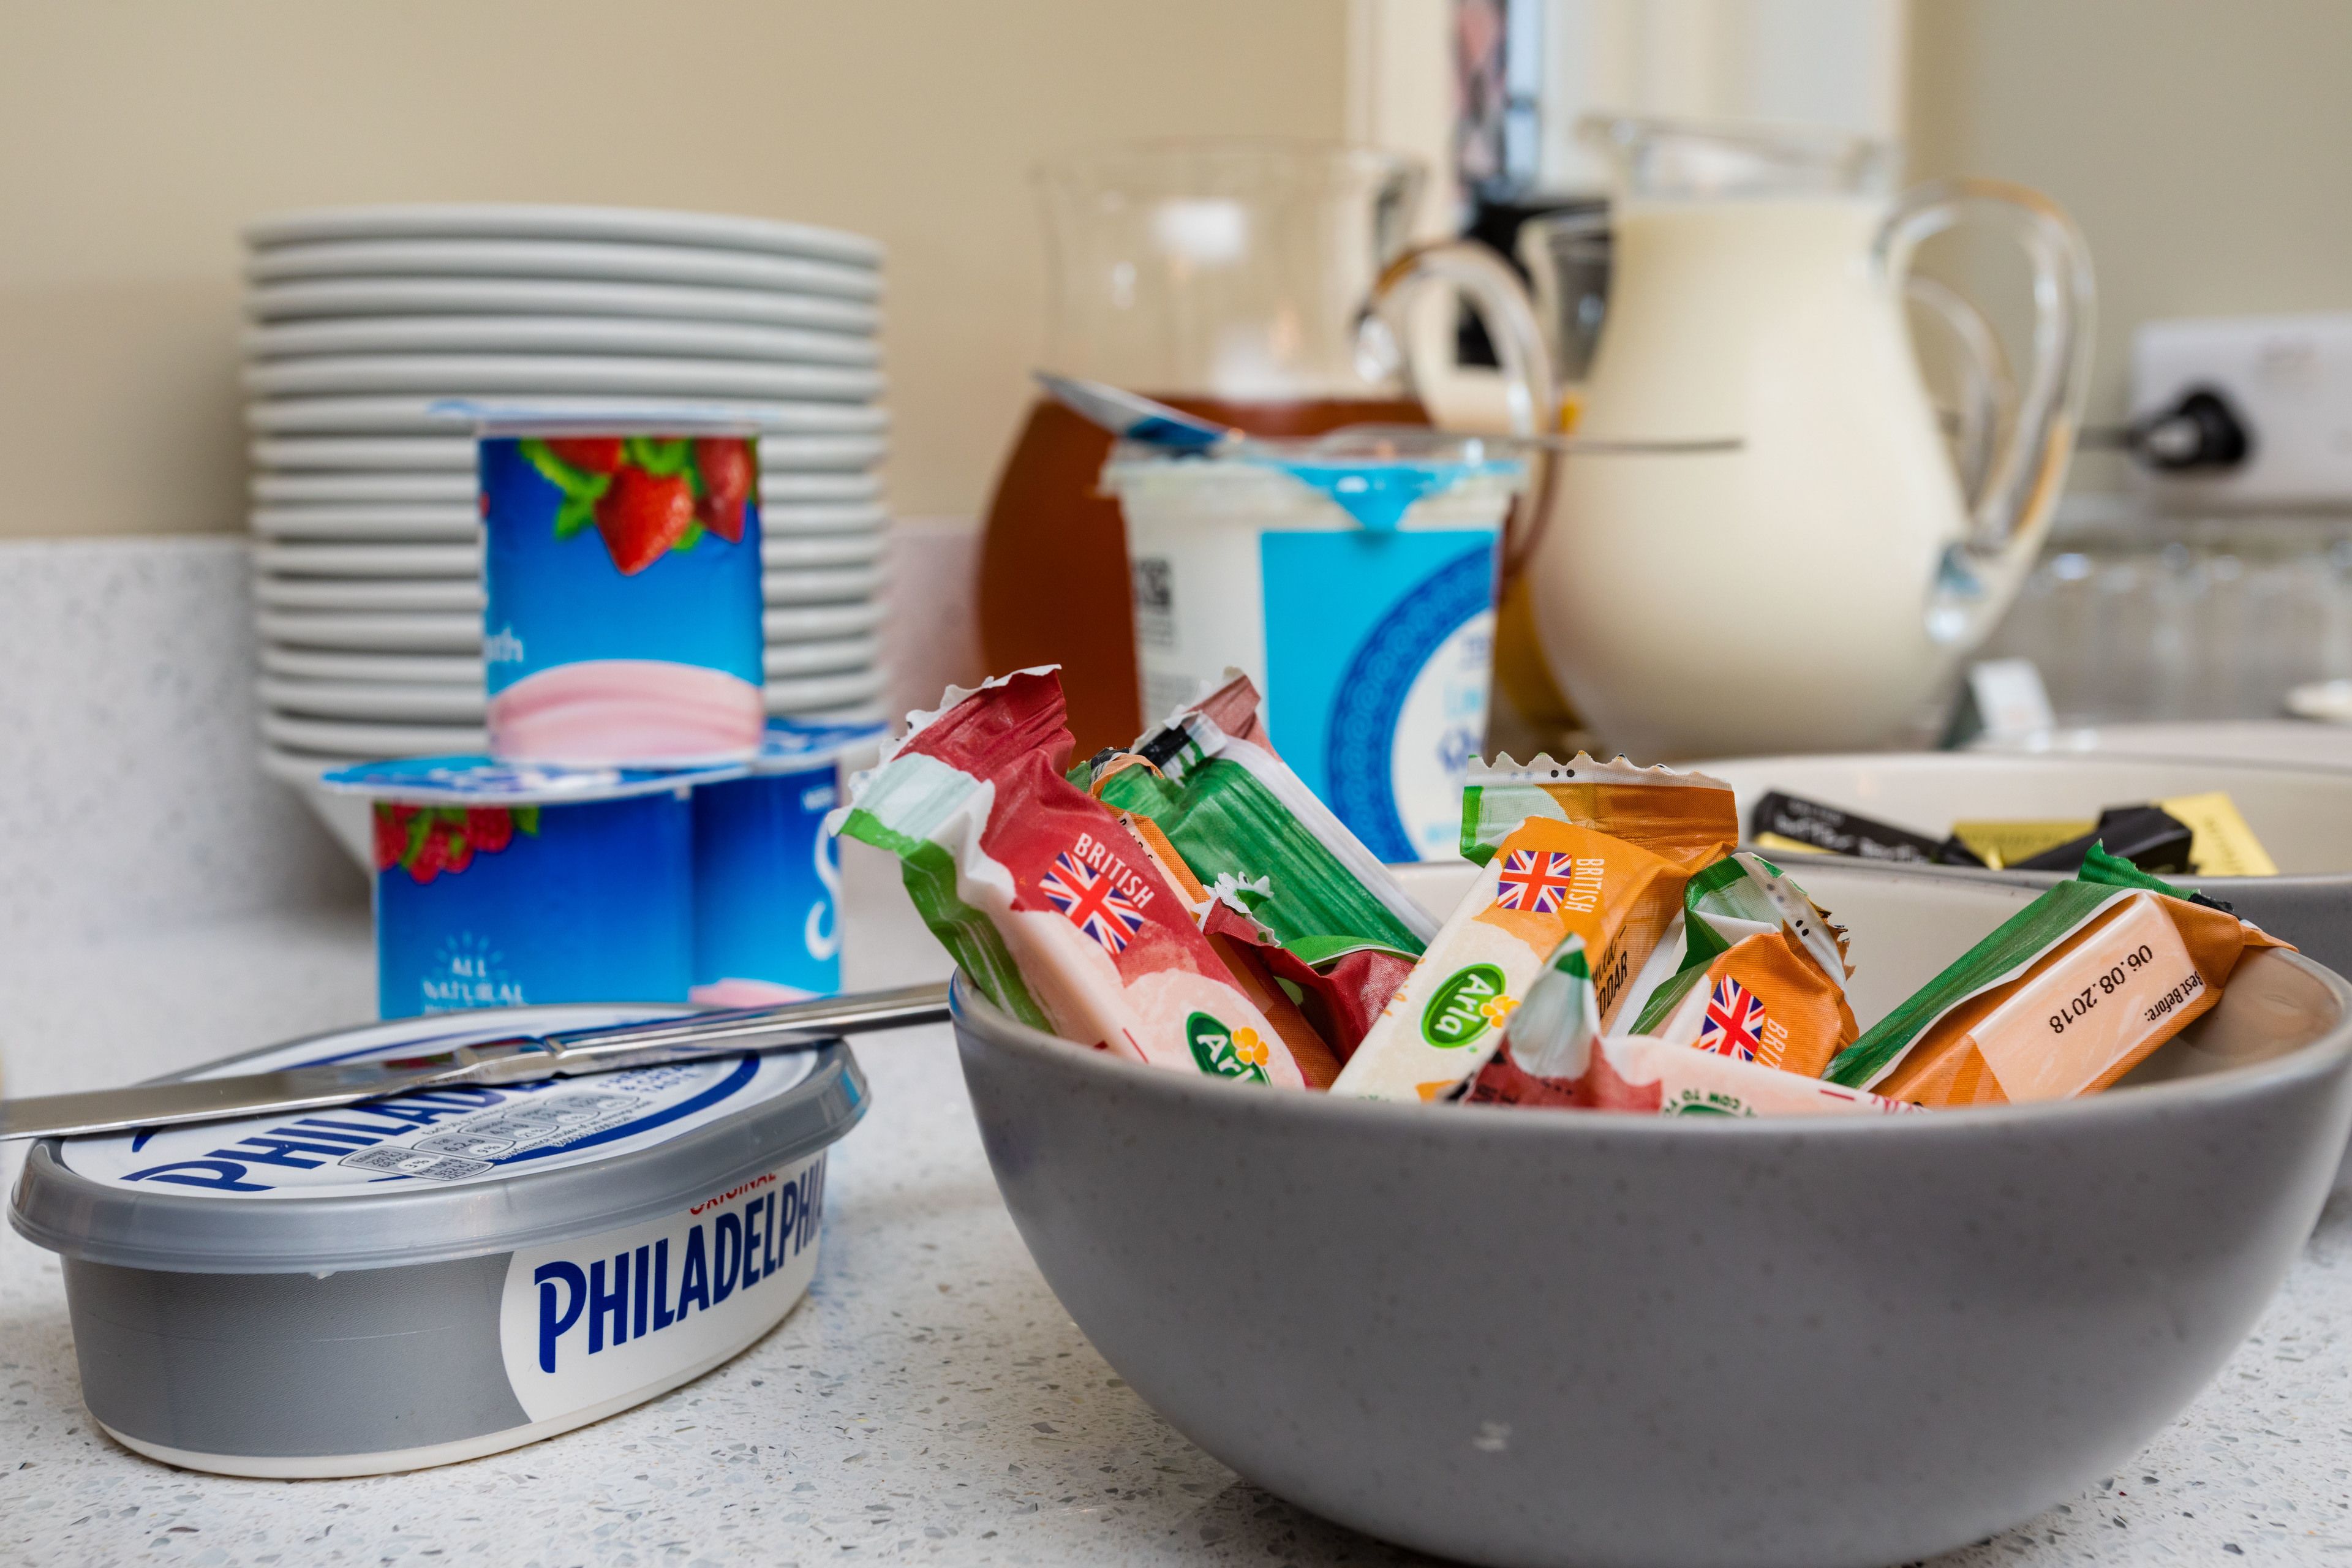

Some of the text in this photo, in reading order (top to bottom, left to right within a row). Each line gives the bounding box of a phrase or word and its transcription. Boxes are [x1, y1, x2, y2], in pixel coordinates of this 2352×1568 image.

[1073, 832, 1155, 910] BRITISH
[1564, 858, 1605, 913] BRITISH
[452, 957, 486, 978] ALL
[1596, 951, 1627, 1020] DDAR
[2049, 944, 2153, 1034] 06.08.2018
[2144, 970, 2204, 1022] Best Before:
[1434, 973, 1495, 1036] Arla
[1196, 1034, 1255, 1083] Arl
[1753, 1017, 1788, 1070] BRIT
[118, 1082, 554, 1192] PHILAD
[350, 1150, 390, 1163] Energy
[534, 1152, 827, 1373] PHILADELPHI
